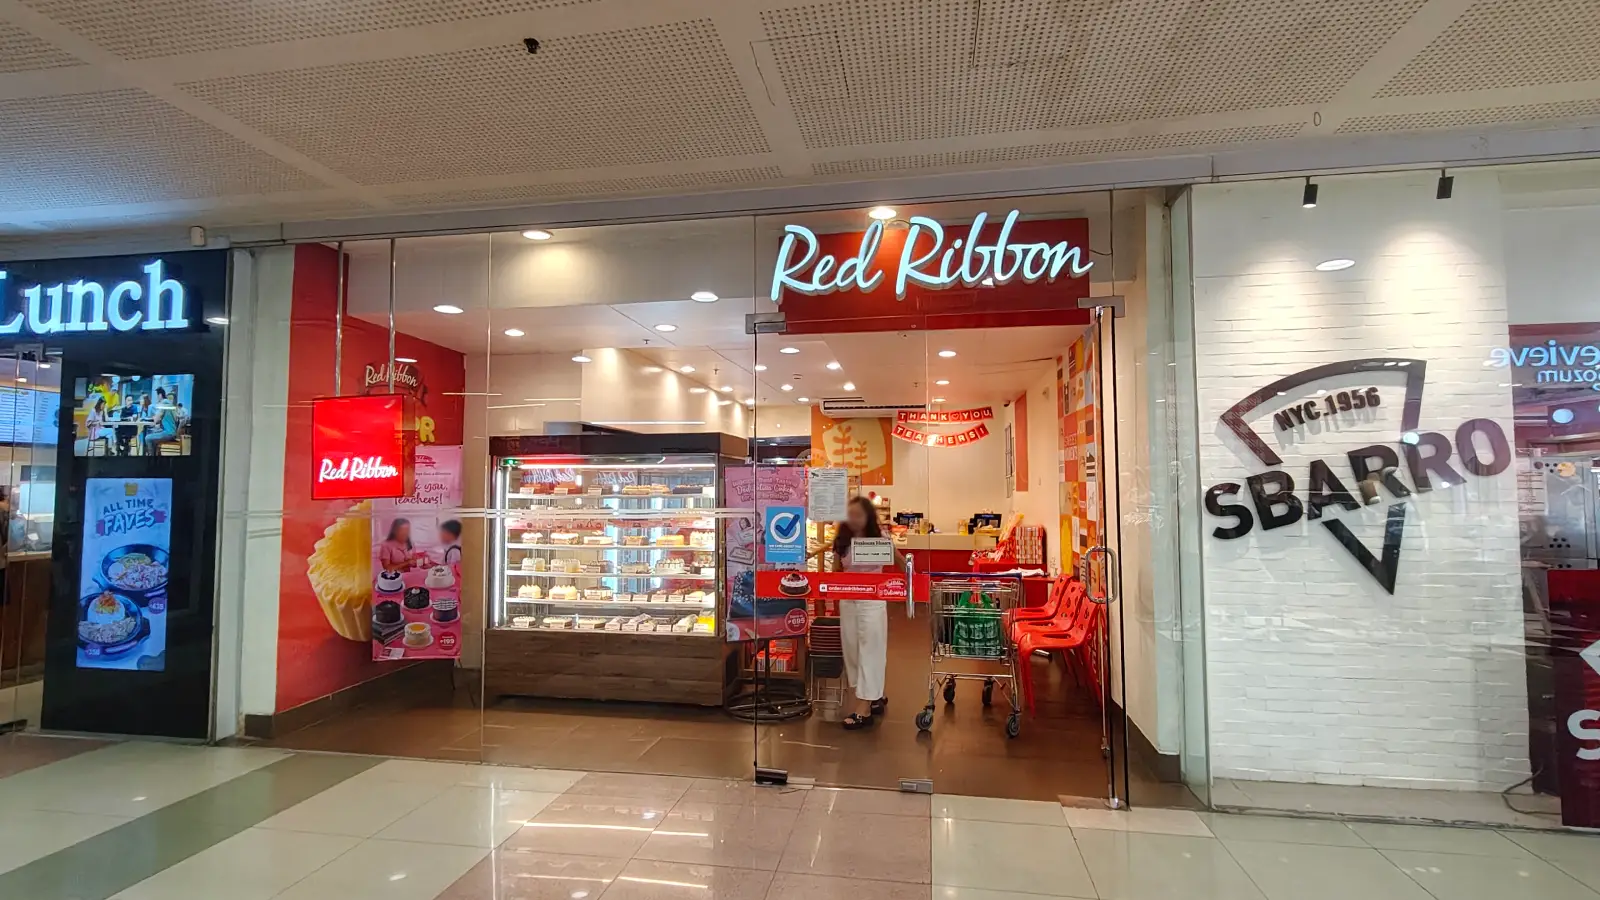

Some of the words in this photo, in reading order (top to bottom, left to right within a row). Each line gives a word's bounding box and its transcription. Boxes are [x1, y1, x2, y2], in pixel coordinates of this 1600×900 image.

[770, 220, 884, 302] Red
[895, 210, 1094, 300] Ribbon
[365, 364, 387, 387] Red
[900, 411, 947, 420] THANK
[896, 427, 985, 445] TEAHERS!
[319, 458, 349, 483] Red
[349, 456, 399, 482] Ribbon
[1204, 418, 1512, 540] SBARRO
[425, 482, 448, 493] you,
[103, 501, 123, 515] ALL
[125, 498, 155, 509] TIME
[104, 508, 156, 536] FAVES
